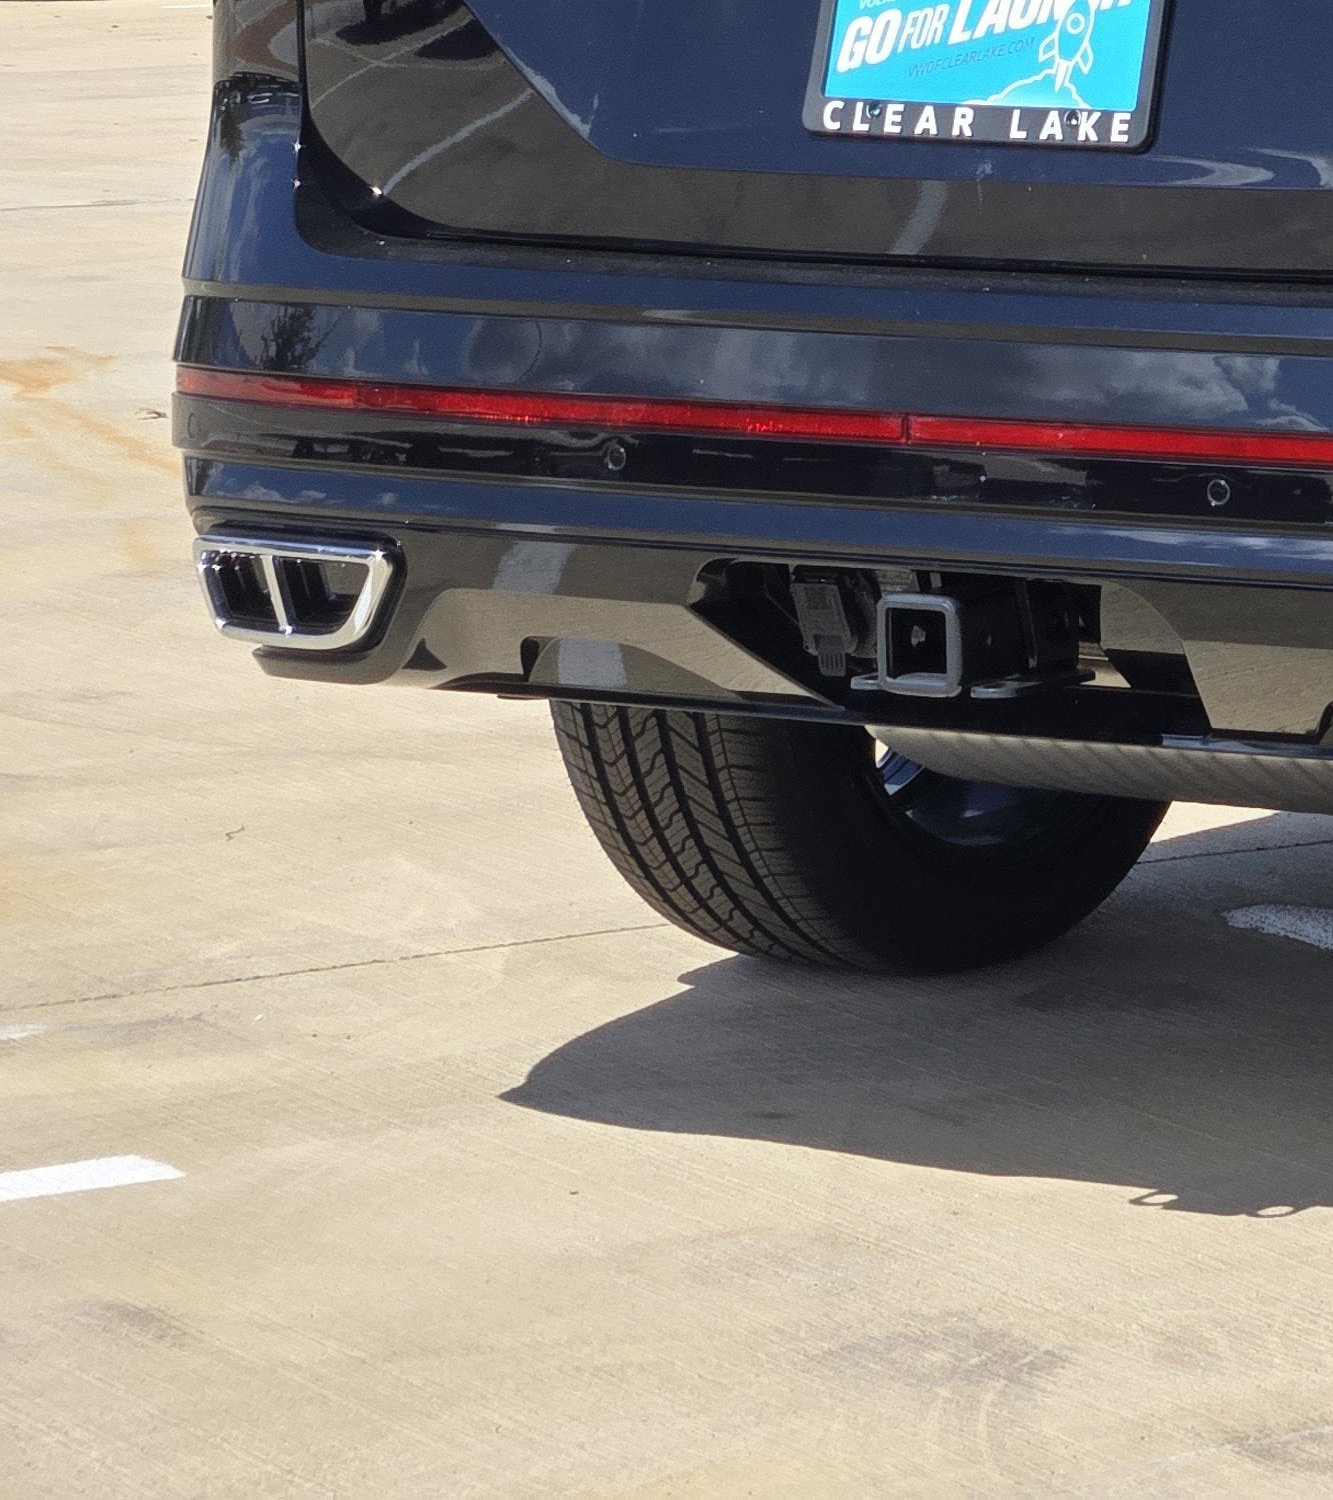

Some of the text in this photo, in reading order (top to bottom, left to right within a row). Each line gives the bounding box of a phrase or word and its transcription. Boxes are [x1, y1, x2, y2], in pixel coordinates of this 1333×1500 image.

[836, 8, 902, 73] GO
[897, 3, 950, 54] FOR
[908, 37, 1035, 78] VWOFCLEARLAKE.COM
[822, 100, 1132, 144] CLEAR LAKE
